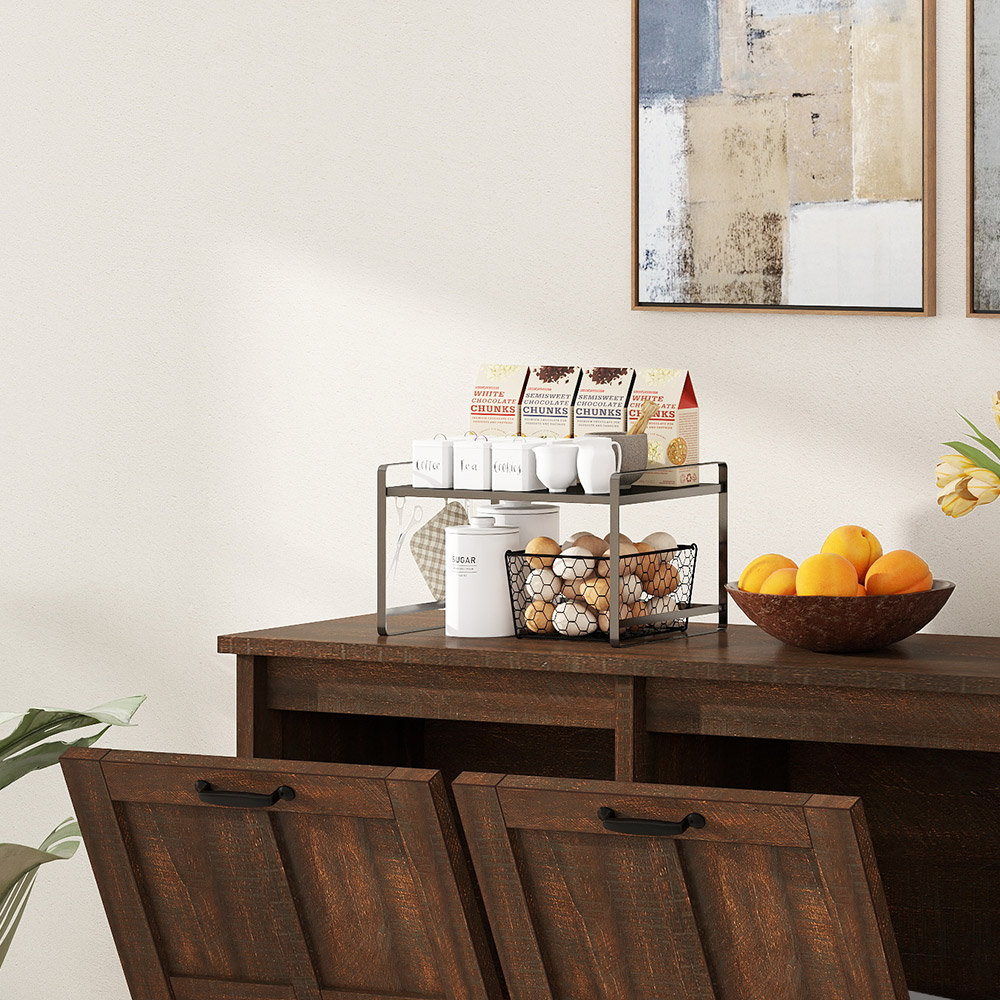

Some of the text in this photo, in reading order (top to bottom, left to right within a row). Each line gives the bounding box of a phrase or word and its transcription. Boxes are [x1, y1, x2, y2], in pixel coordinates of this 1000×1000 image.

[470, 404, 516, 413] CHUNKS
[523, 406, 569, 415] CHUNKS
[575, 407, 622, 416] CHUNKS
[460, 459, 478, 472] Tea
[452, 555, 476, 564] SUGAR
